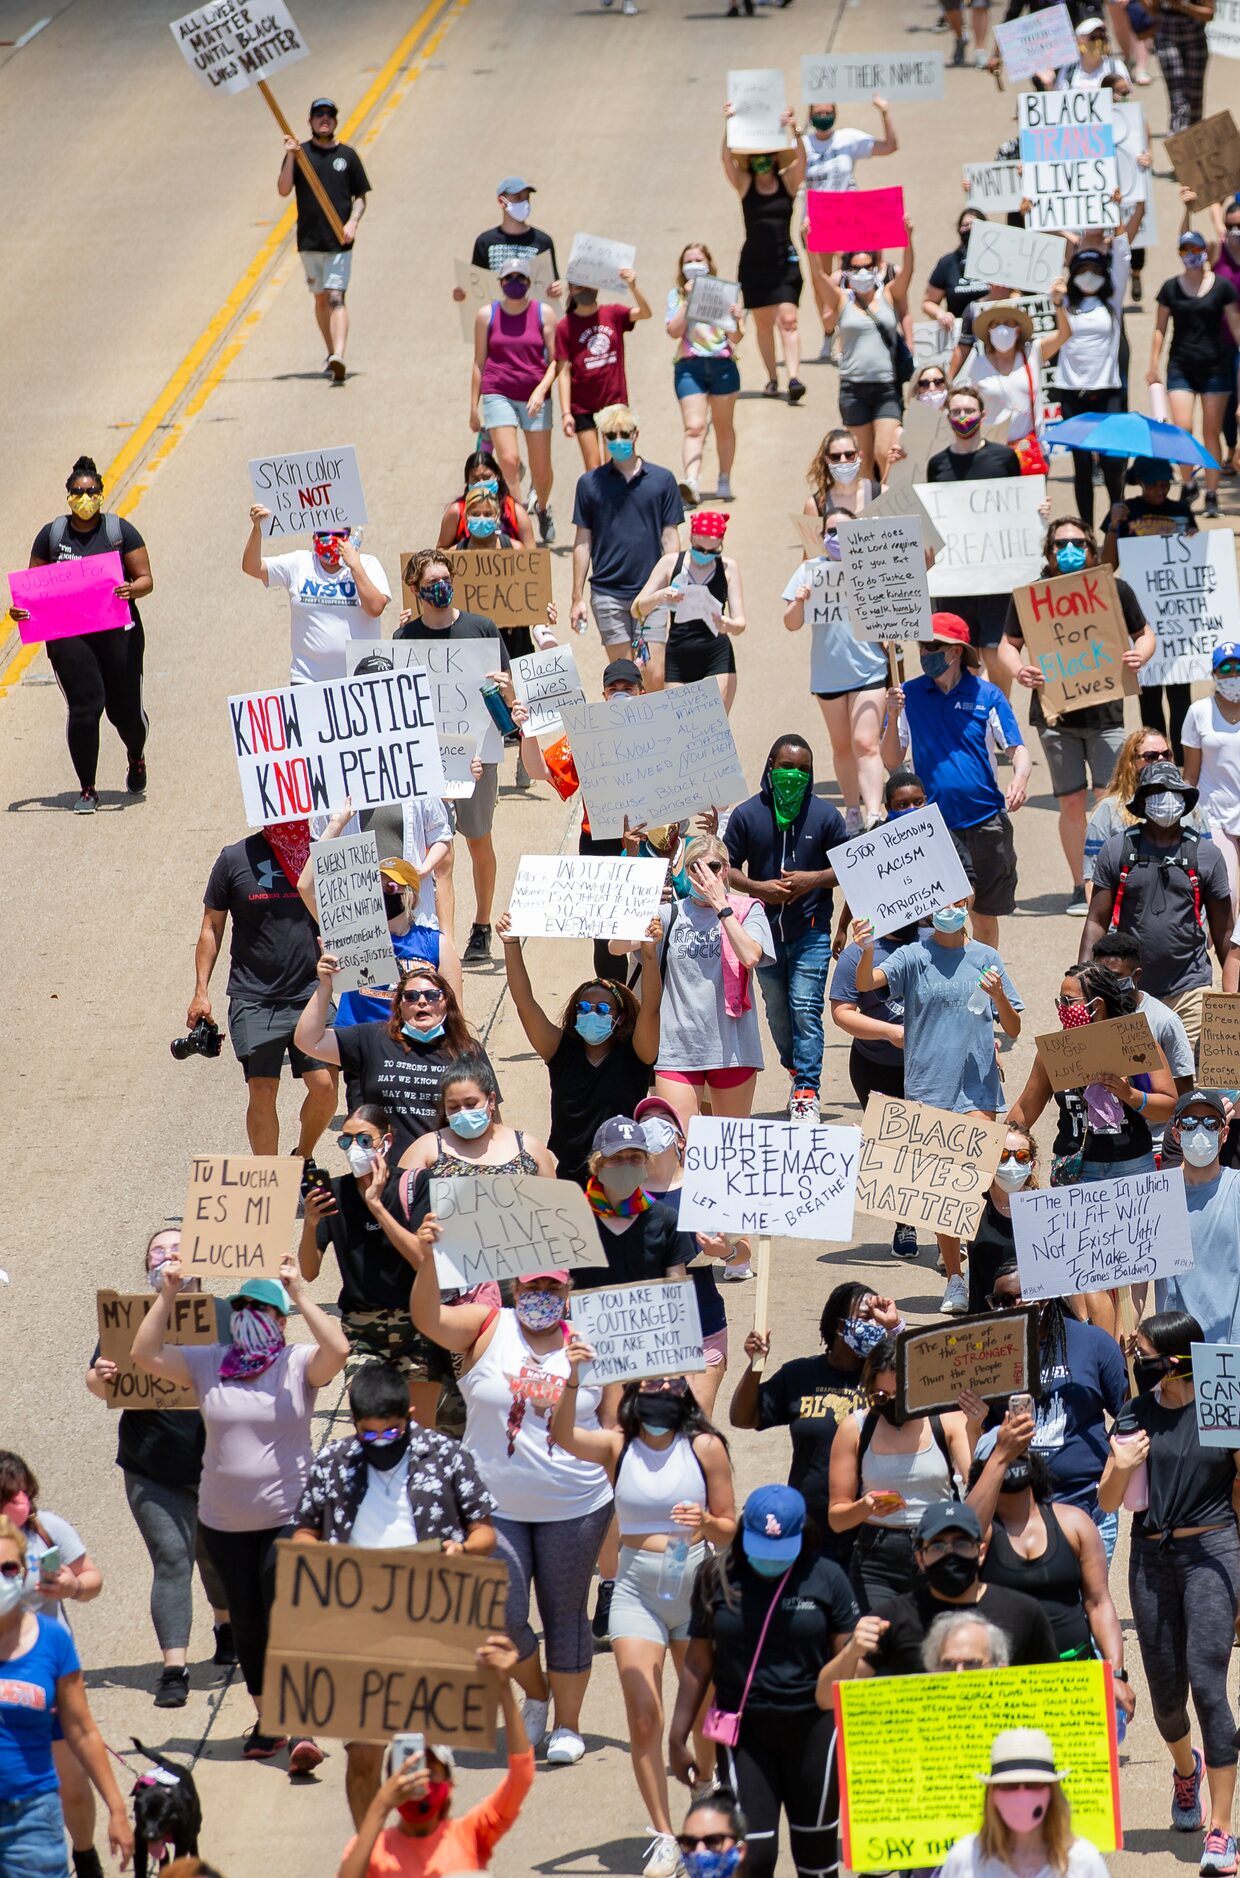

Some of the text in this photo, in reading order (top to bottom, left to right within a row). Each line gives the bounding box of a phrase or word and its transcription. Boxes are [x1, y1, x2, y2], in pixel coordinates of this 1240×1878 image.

[179, 19, 201, 39] ALL
[189, 9, 252, 52] MATTER
[194, 15, 281, 70] UNTIL BLACK
[238, 29, 300, 74] MATTER
[808, 61, 936, 91] SAY THEIR NAMES
[1027, 92, 1103, 127] BLACK
[1028, 126, 1106, 160] TRANS
[1034, 160, 1107, 194] LIVES
[1026, 193, 1116, 227] MATTER
[976, 228, 1051, 283] 8:46
[256, 461, 304, 490] Skin
[297, 484, 333, 509] NOT
[269, 506, 349, 536] A crime
[848, 529, 904, 545] What does
[1161, 533, 1192, 565] IS
[474, 552, 542, 578] JUSTICE
[1145, 569, 1178, 592] HER
[299, 578, 357, 599] NSU
[464, 582, 539, 614] PEACE
[1029, 577, 1108, 623] Honk
[1156, 597, 1208, 615] WORTH
[1053, 623, 1099, 649] for
[1188, 615, 1223, 632] THAN
[519, 655, 567, 680] Black
[1038, 639, 1115, 683] Black
[526, 678, 567, 701] Lives
[1062, 676, 1115, 701] Lives
[230, 673, 435, 756] KNOW JUSTICE
[256, 740, 428, 819] KNOW PEACE
[317, 841, 378, 874] EVERY TRIBE
[876, 845, 925, 880] RACISM
[318, 879, 348, 909] EVERY
[321, 896, 383, 931] EVERY NATION
[1204, 998, 1236, 1010] George
[1203, 1029, 1240, 1041] Michael
[378, 1074, 438, 1086] MAY KNOW
[384, 1060, 428, 1072] TO STRONG
[720, 1122, 829, 1151] WHITE
[878, 1102, 990, 1158] BLACK
[687, 1146, 855, 1177] SUPREMACY
[859, 1138, 980, 1193] LIVES
[434, 1178, 544, 1220] BLACK
[726, 1170, 812, 1199] KILLS
[1068, 1174, 1170, 1205] Place In Which
[196, 1194, 271, 1226] ES MI
[691, 1191, 769, 1230] LET ME
[856, 1175, 983, 1235] MATTER
[1084, 1195, 1150, 1227] Fit Will
[474, 1208, 579, 1249] LIVES
[1032, 1214, 1161, 1262] Not Exist Until
[462, 1236, 592, 1281] MATTER
[1091, 1249, 1130, 1270] Make
[600, 1285, 683, 1308] YOU ARE NOT
[597, 1302, 679, 1333] OUTRAGED
[622, 1330, 680, 1351] ARE NOT
[953, 1344, 1018, 1367] STRONGER
[593, 1344, 704, 1378] PAYING ATTENTION
[1216, 1353, 1236, 1379] I
[919, 1374, 946, 1388] Than
[291, 1555, 512, 1631] NO JUSTICE
[278, 1661, 488, 1733] NO PEACE
[866, 1836, 914, 1862] SAY
